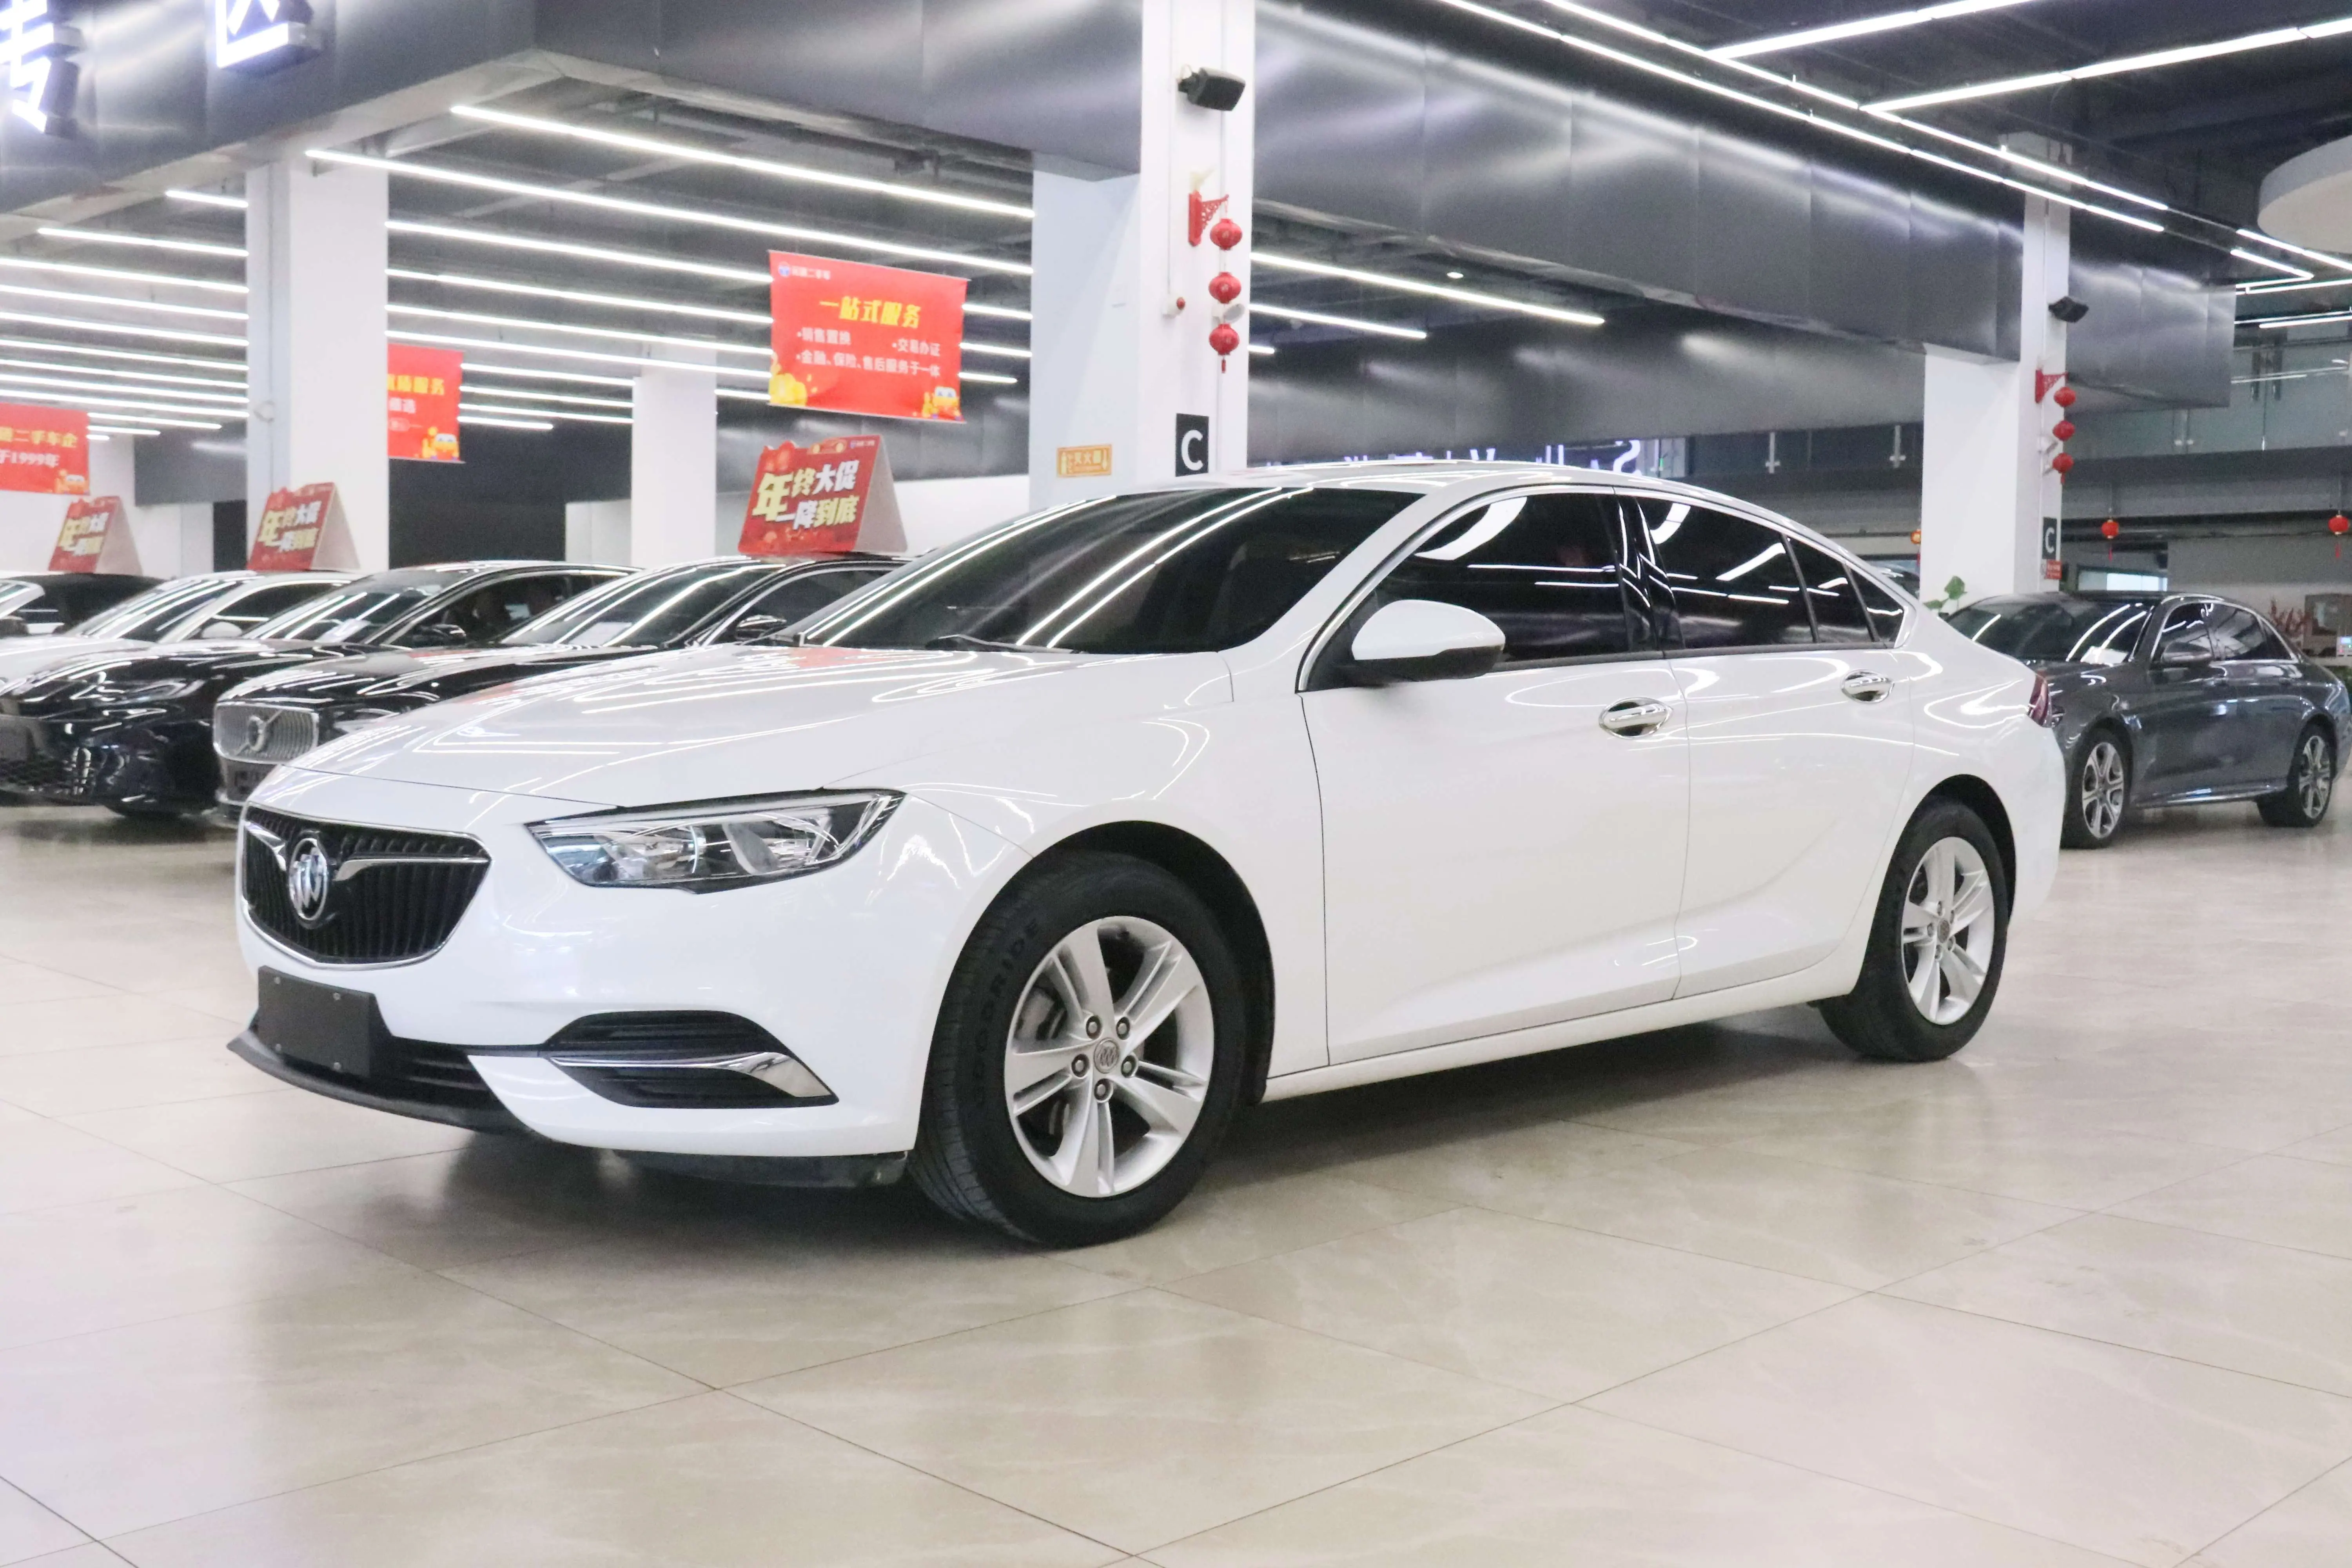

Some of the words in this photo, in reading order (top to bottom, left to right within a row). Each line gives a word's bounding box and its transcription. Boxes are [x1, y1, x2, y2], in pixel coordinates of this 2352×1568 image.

[820, 296, 921, 328] 一站式服务
[897, 338, 940, 357] 交易办证
[1181, 430, 1203, 471] C
[752, 459, 860, 522] 年终大促
[775, 495, 860, 530] 一降到底
[2045, 527, 2055, 554] C
